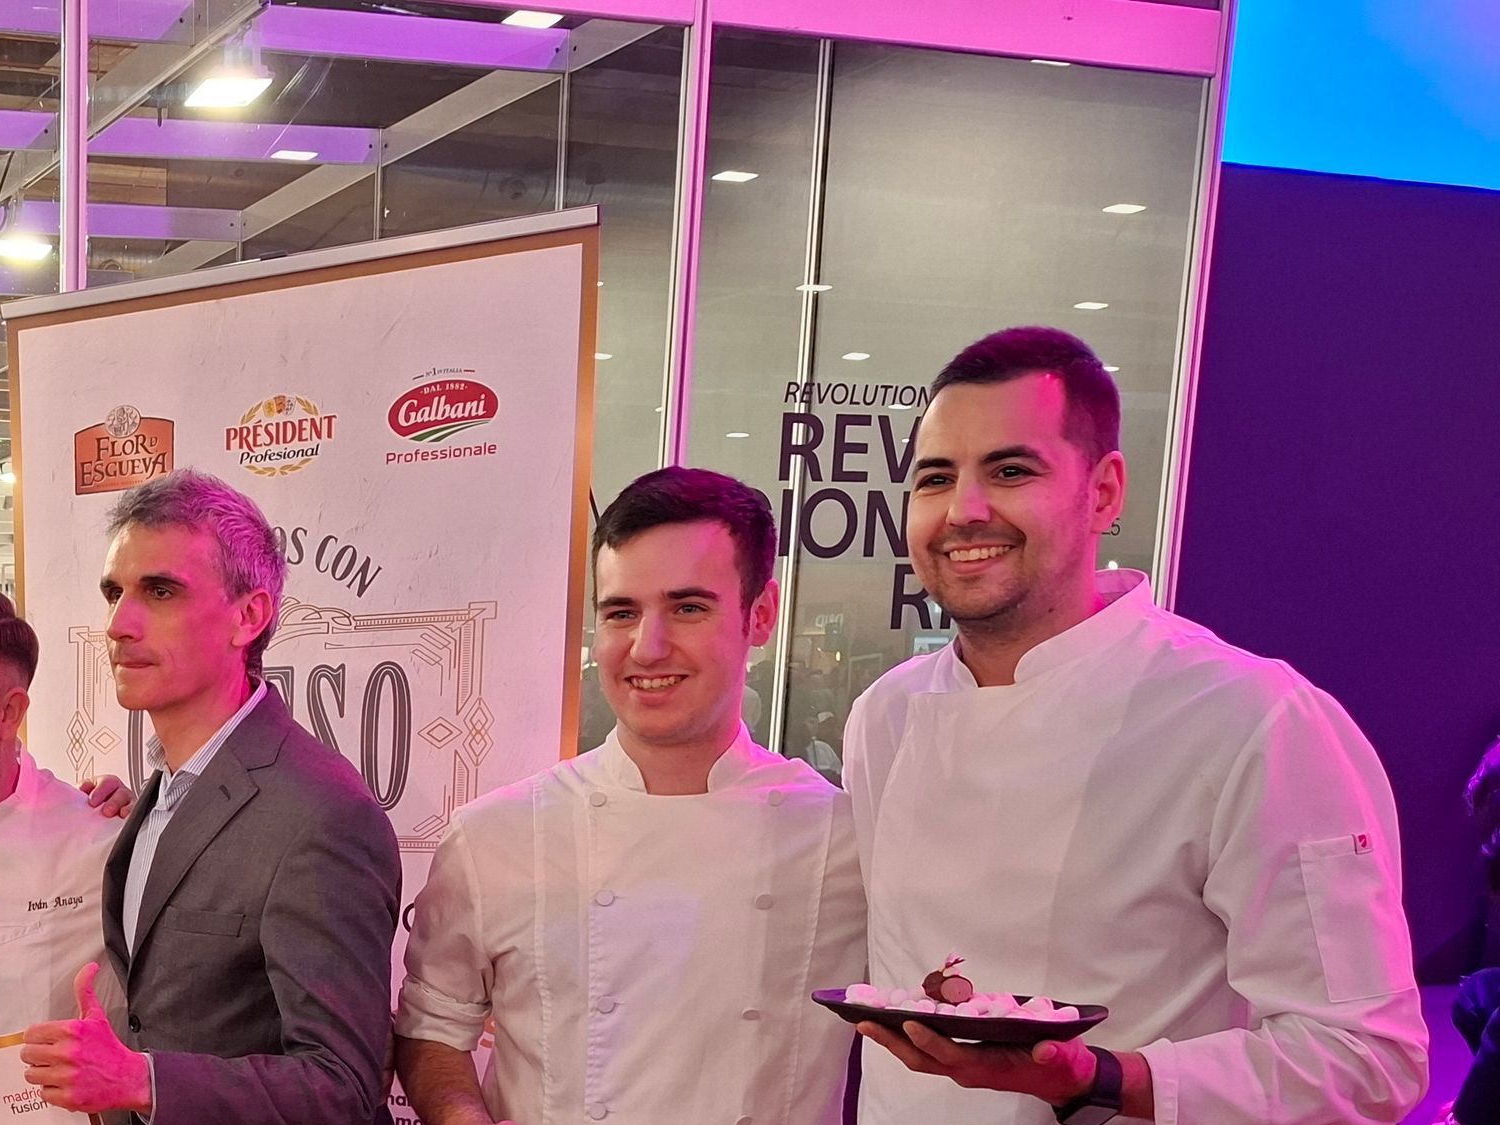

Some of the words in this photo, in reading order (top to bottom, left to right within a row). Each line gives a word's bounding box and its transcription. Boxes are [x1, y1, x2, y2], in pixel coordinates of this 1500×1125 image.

[398, 394, 487, 427] Galbani
[225, 414, 337, 452] PRÉSIDENT
[95, 434, 154, 461] FLOR
[239, 443, 321, 465] Profesional
[386, 442, 497, 465] Professionale
[80, 452, 167, 486] ESGUEVA
[315, 534, 383, 599] CON
[52, 895, 84, 910] Anaya
[11, 1099, 48, 1115] fusión
